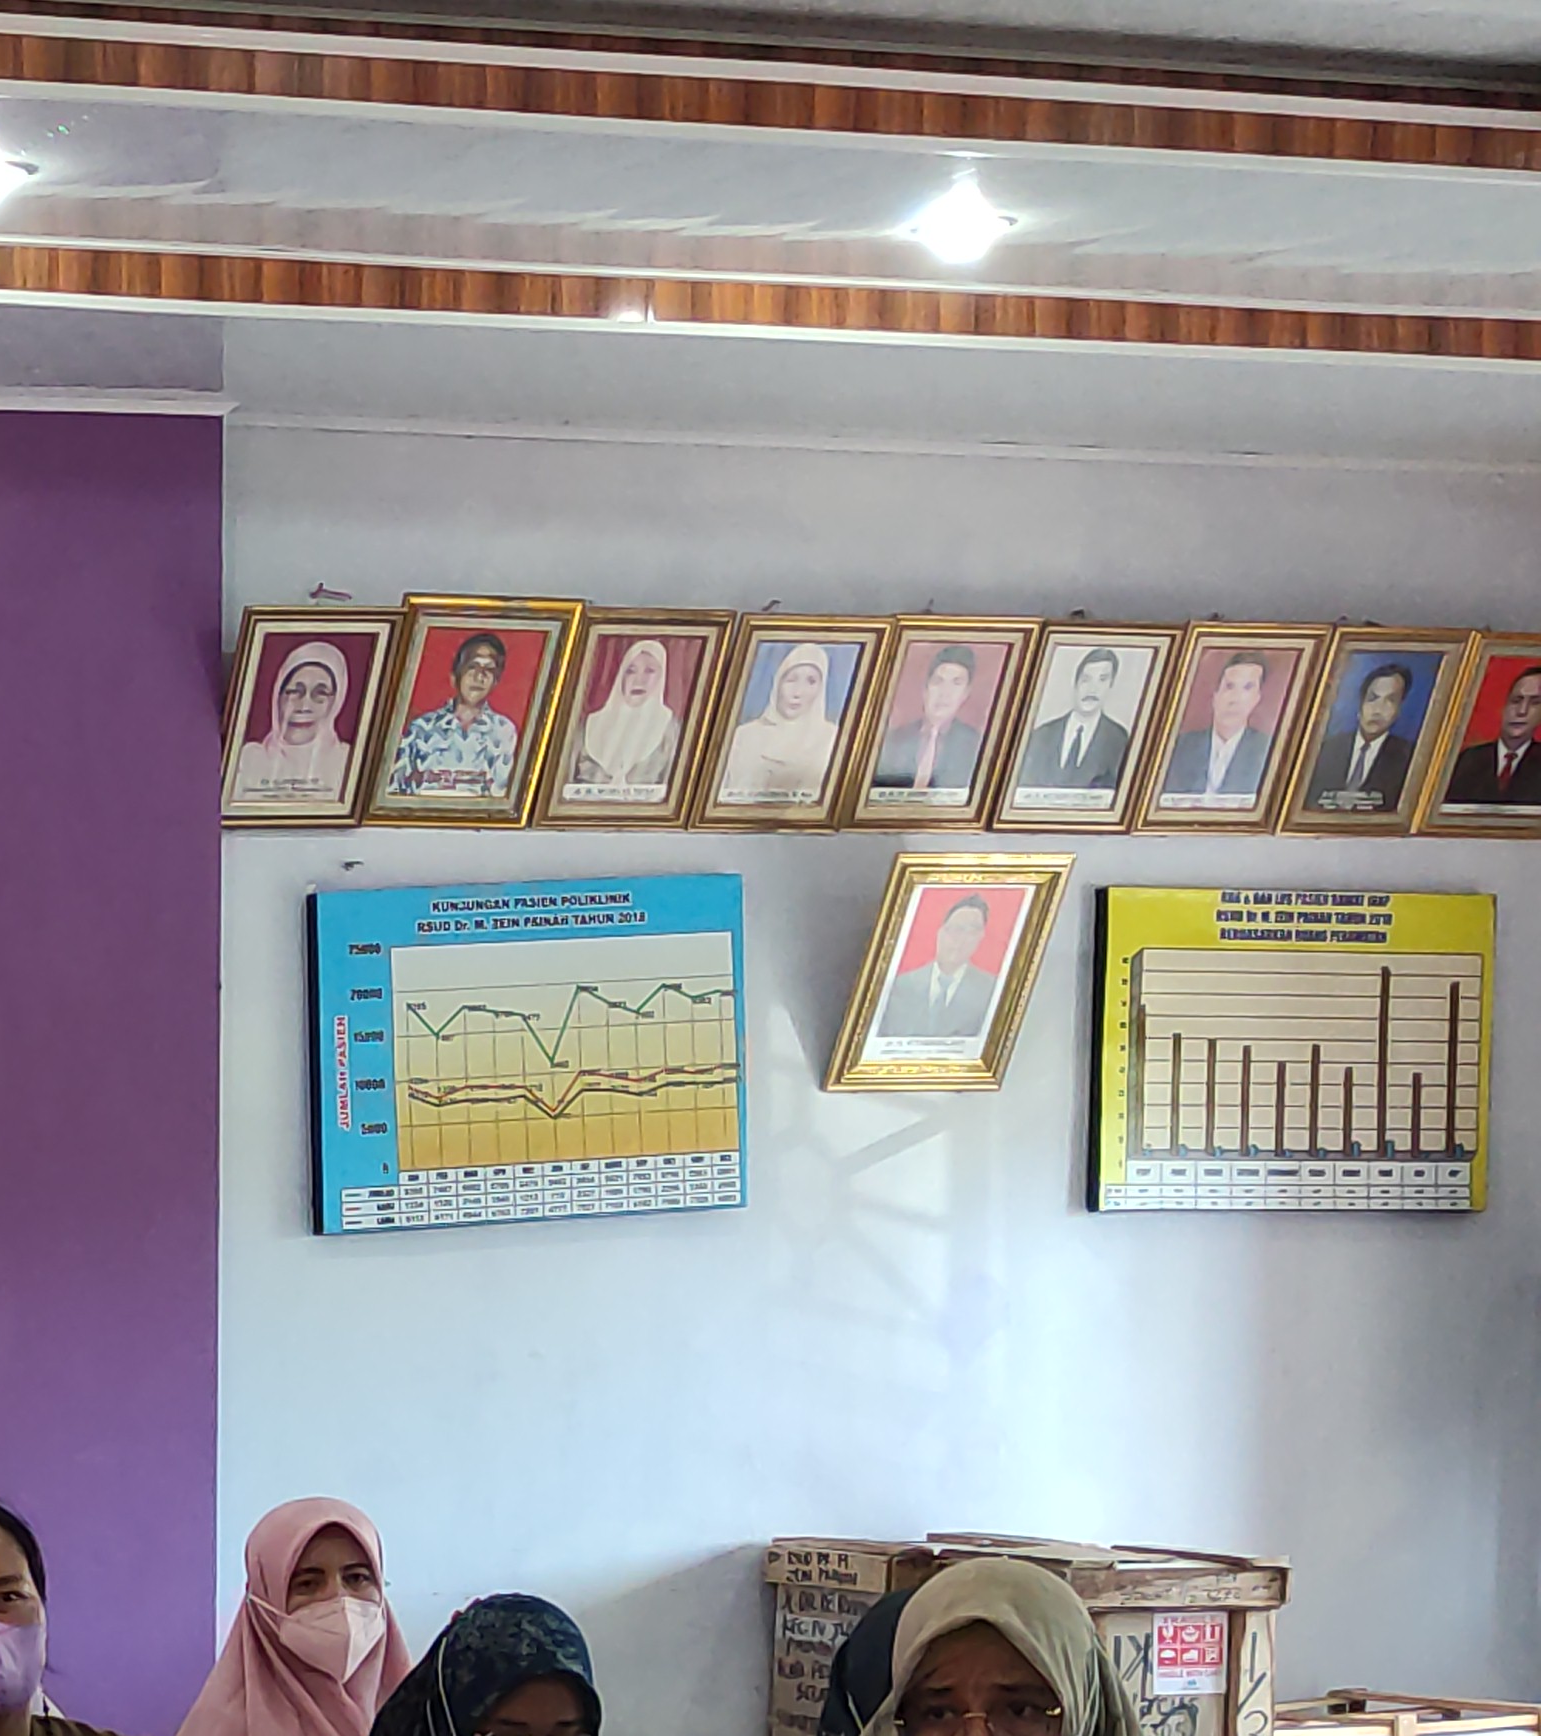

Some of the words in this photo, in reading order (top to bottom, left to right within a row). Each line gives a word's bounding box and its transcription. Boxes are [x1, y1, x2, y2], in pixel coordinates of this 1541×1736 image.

[560, 892, 631, 907] POLIKLINIK
[417, 920, 452, 933] RSUD
[573, 912, 615, 926] TAHUN
